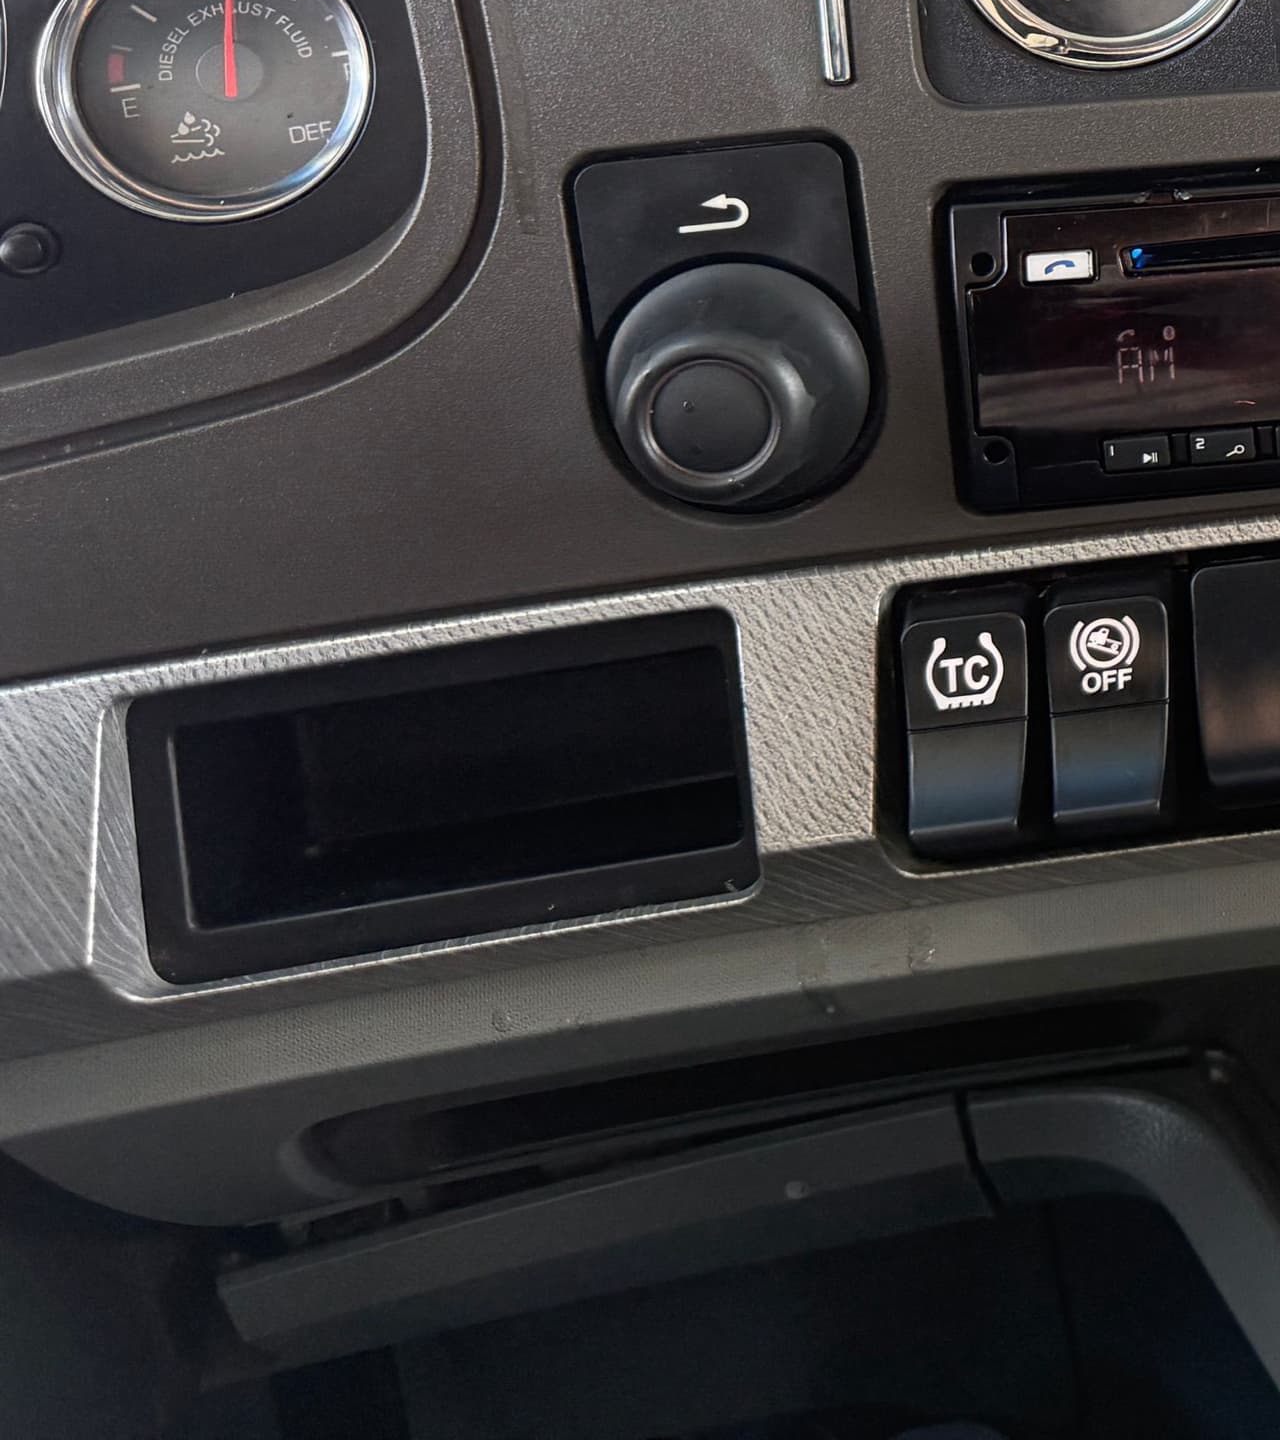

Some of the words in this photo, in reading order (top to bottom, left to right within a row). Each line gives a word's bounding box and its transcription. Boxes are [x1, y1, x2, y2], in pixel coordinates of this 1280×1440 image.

[158, 27, 189, 81] DIESEL
[187, 1, 276, 27] EXHUST
[275, 16, 313, 58] FLUID
[121, 97, 140, 119] E
[289, 120, 332, 145] DEF
[1109, 445, 1115, 456] 1
[1195, 438, 1205, 450] 2
[939, 655, 990, 693] TC
[1082, 667, 1133, 694] OFF
